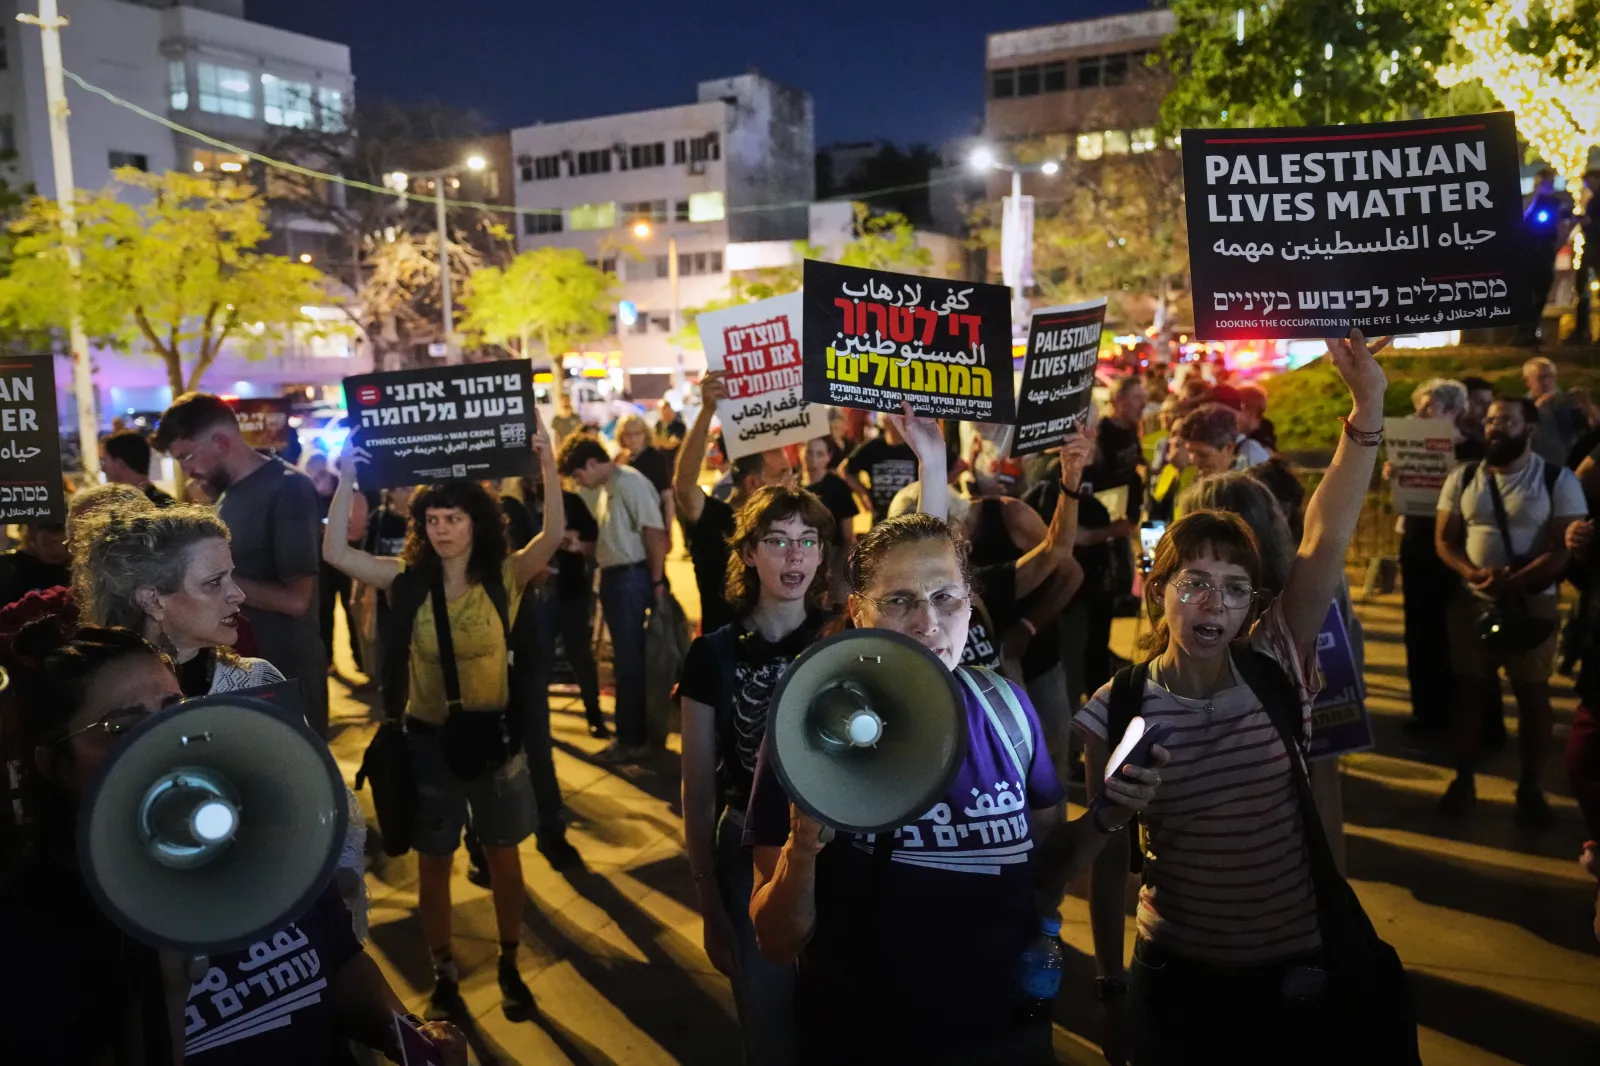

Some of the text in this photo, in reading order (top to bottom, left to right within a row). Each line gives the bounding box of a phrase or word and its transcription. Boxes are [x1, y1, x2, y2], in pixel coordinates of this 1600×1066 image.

[1205, 140, 1488, 185] PALESTINIAN
[1207, 181, 1494, 223] LIVES MATTER
[1212, 222, 1498, 263] حياه الفلسطينين مهمه
[930, 287, 975, 316] كفى
[1213, 277, 1508, 316] מסתכלים לכיבוש בעיניים
[833, 297, 983, 350] די לטרור
[1215, 315, 1392, 329] LOOKING THE OCCUPATION IN THE EYE
[1433, 309, 1444, 325] في
[1446, 306, 1487, 321] الاحتلال
[727, 320, 787, 352] עוצרים
[831, 329, 986, 366] المستوطنين
[1034, 321, 1102, 354] PALESTINIAN
[726, 342, 796, 375] את טרור
[825, 346, 993, 398] המתנחלים!
[1030, 346, 1099, 380] LIVES MATTER
[385, 380, 446, 402] אתני
[450, 373, 522, 396] טיהור
[360, 395, 524, 428] פשע מלחמה
[365, 436, 397, 447] ETHNIC
[397, 431, 444, 446] CLEANSING
[450, 430, 469, 441] WAR
[469, 428, 495, 440] CRIME
[963, 780, 1026, 819] نقف
[932, 812, 1029, 848] עומדים
[209, 948, 321, 1018] עומדים
